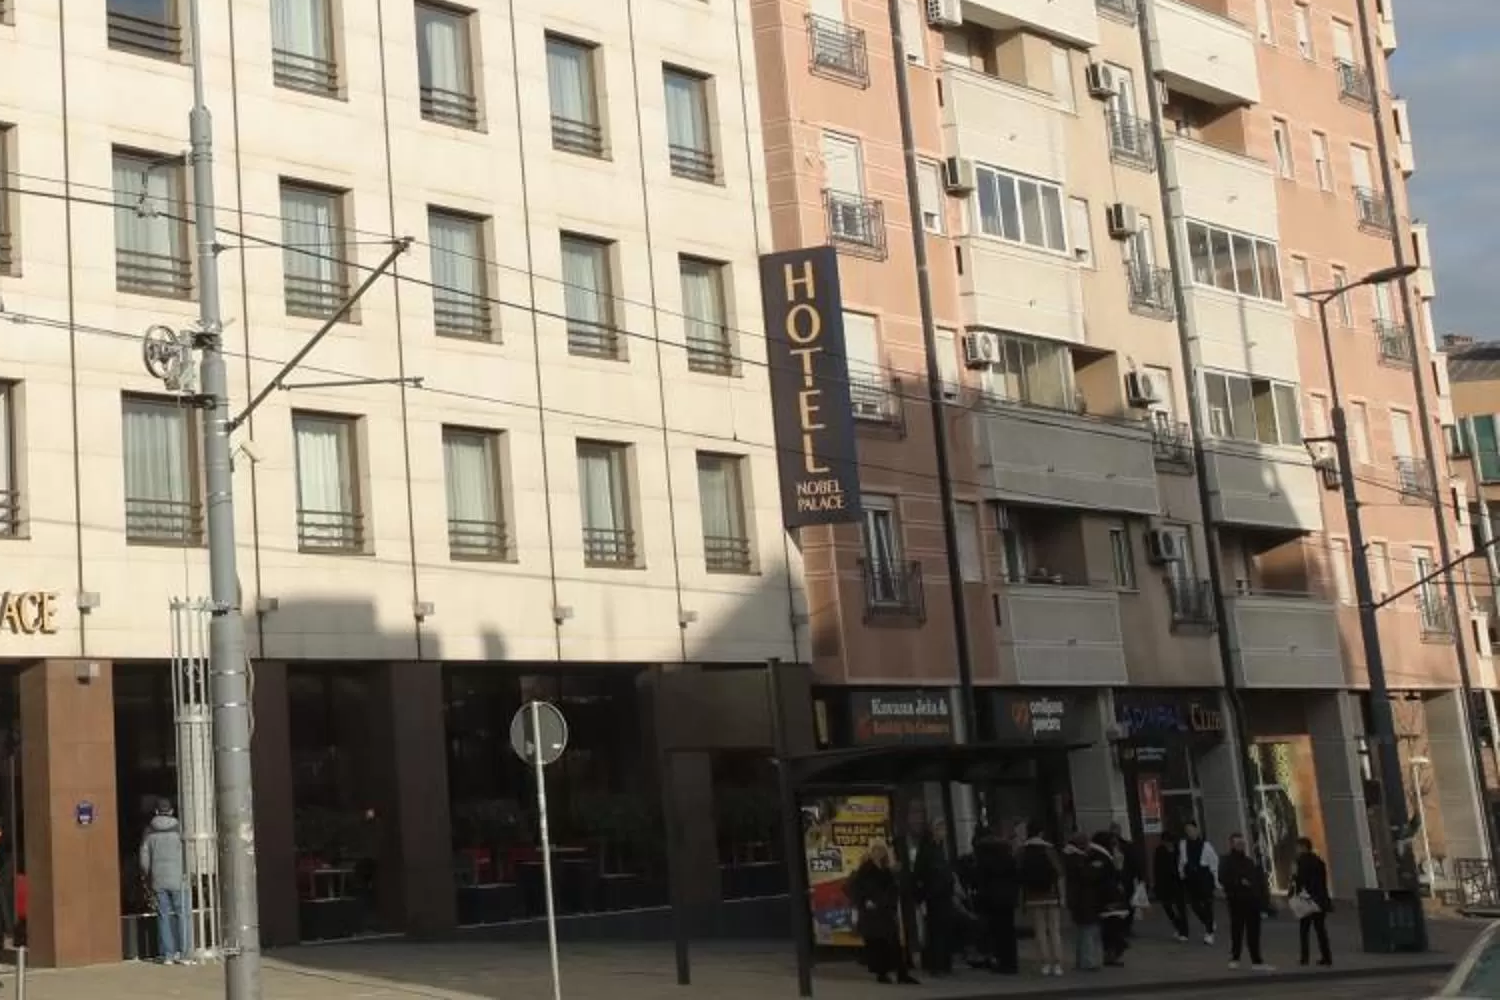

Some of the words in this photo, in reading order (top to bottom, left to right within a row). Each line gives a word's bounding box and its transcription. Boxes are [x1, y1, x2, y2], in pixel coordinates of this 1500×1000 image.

[783, 259, 830, 473] HOTEL
[796, 479, 845, 496] NOBEL
[797, 495, 845, 513] PALACE
